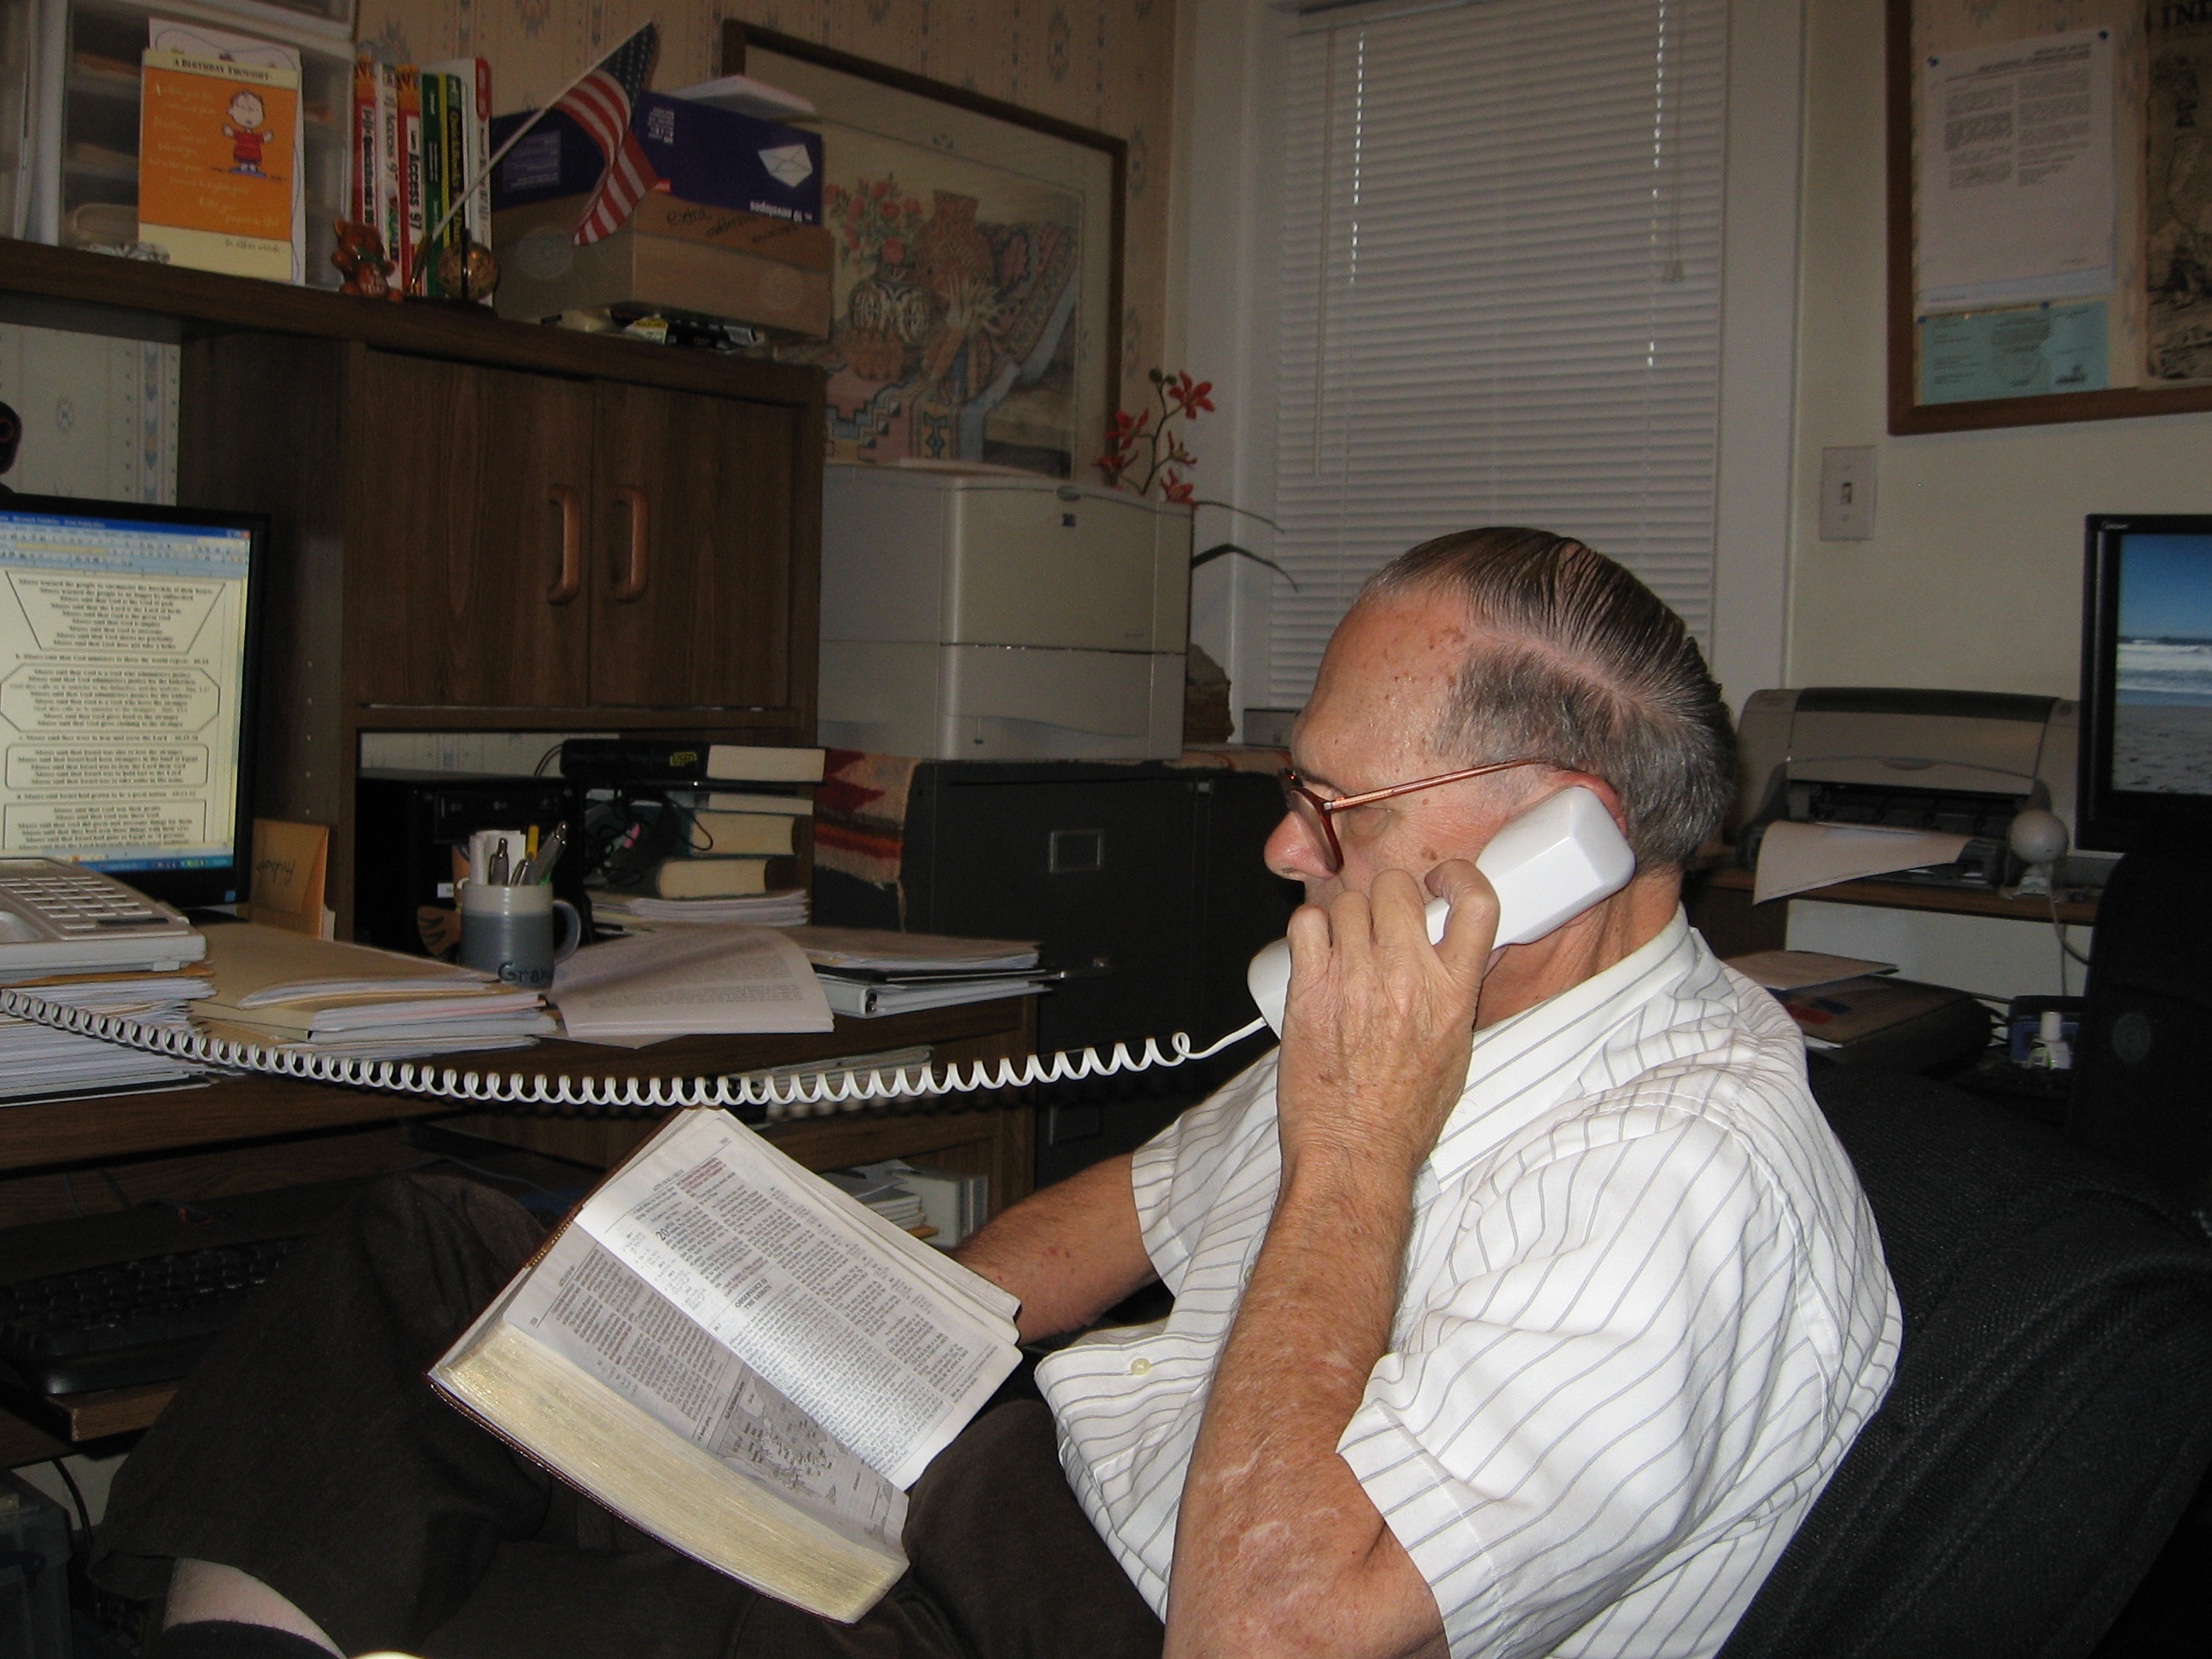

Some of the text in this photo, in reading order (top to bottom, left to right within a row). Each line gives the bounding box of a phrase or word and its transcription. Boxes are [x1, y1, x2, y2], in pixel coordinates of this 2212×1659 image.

[182, 59, 225, 75] BIRTHDAY
[409, 154, 420, 207] Access
[409, 212, 422, 230] 97
[672, 754, 696, 765] USED
[655, 1226, 672, 1242] 20
[733, 1282, 762, 1307] OBSERVANCE
